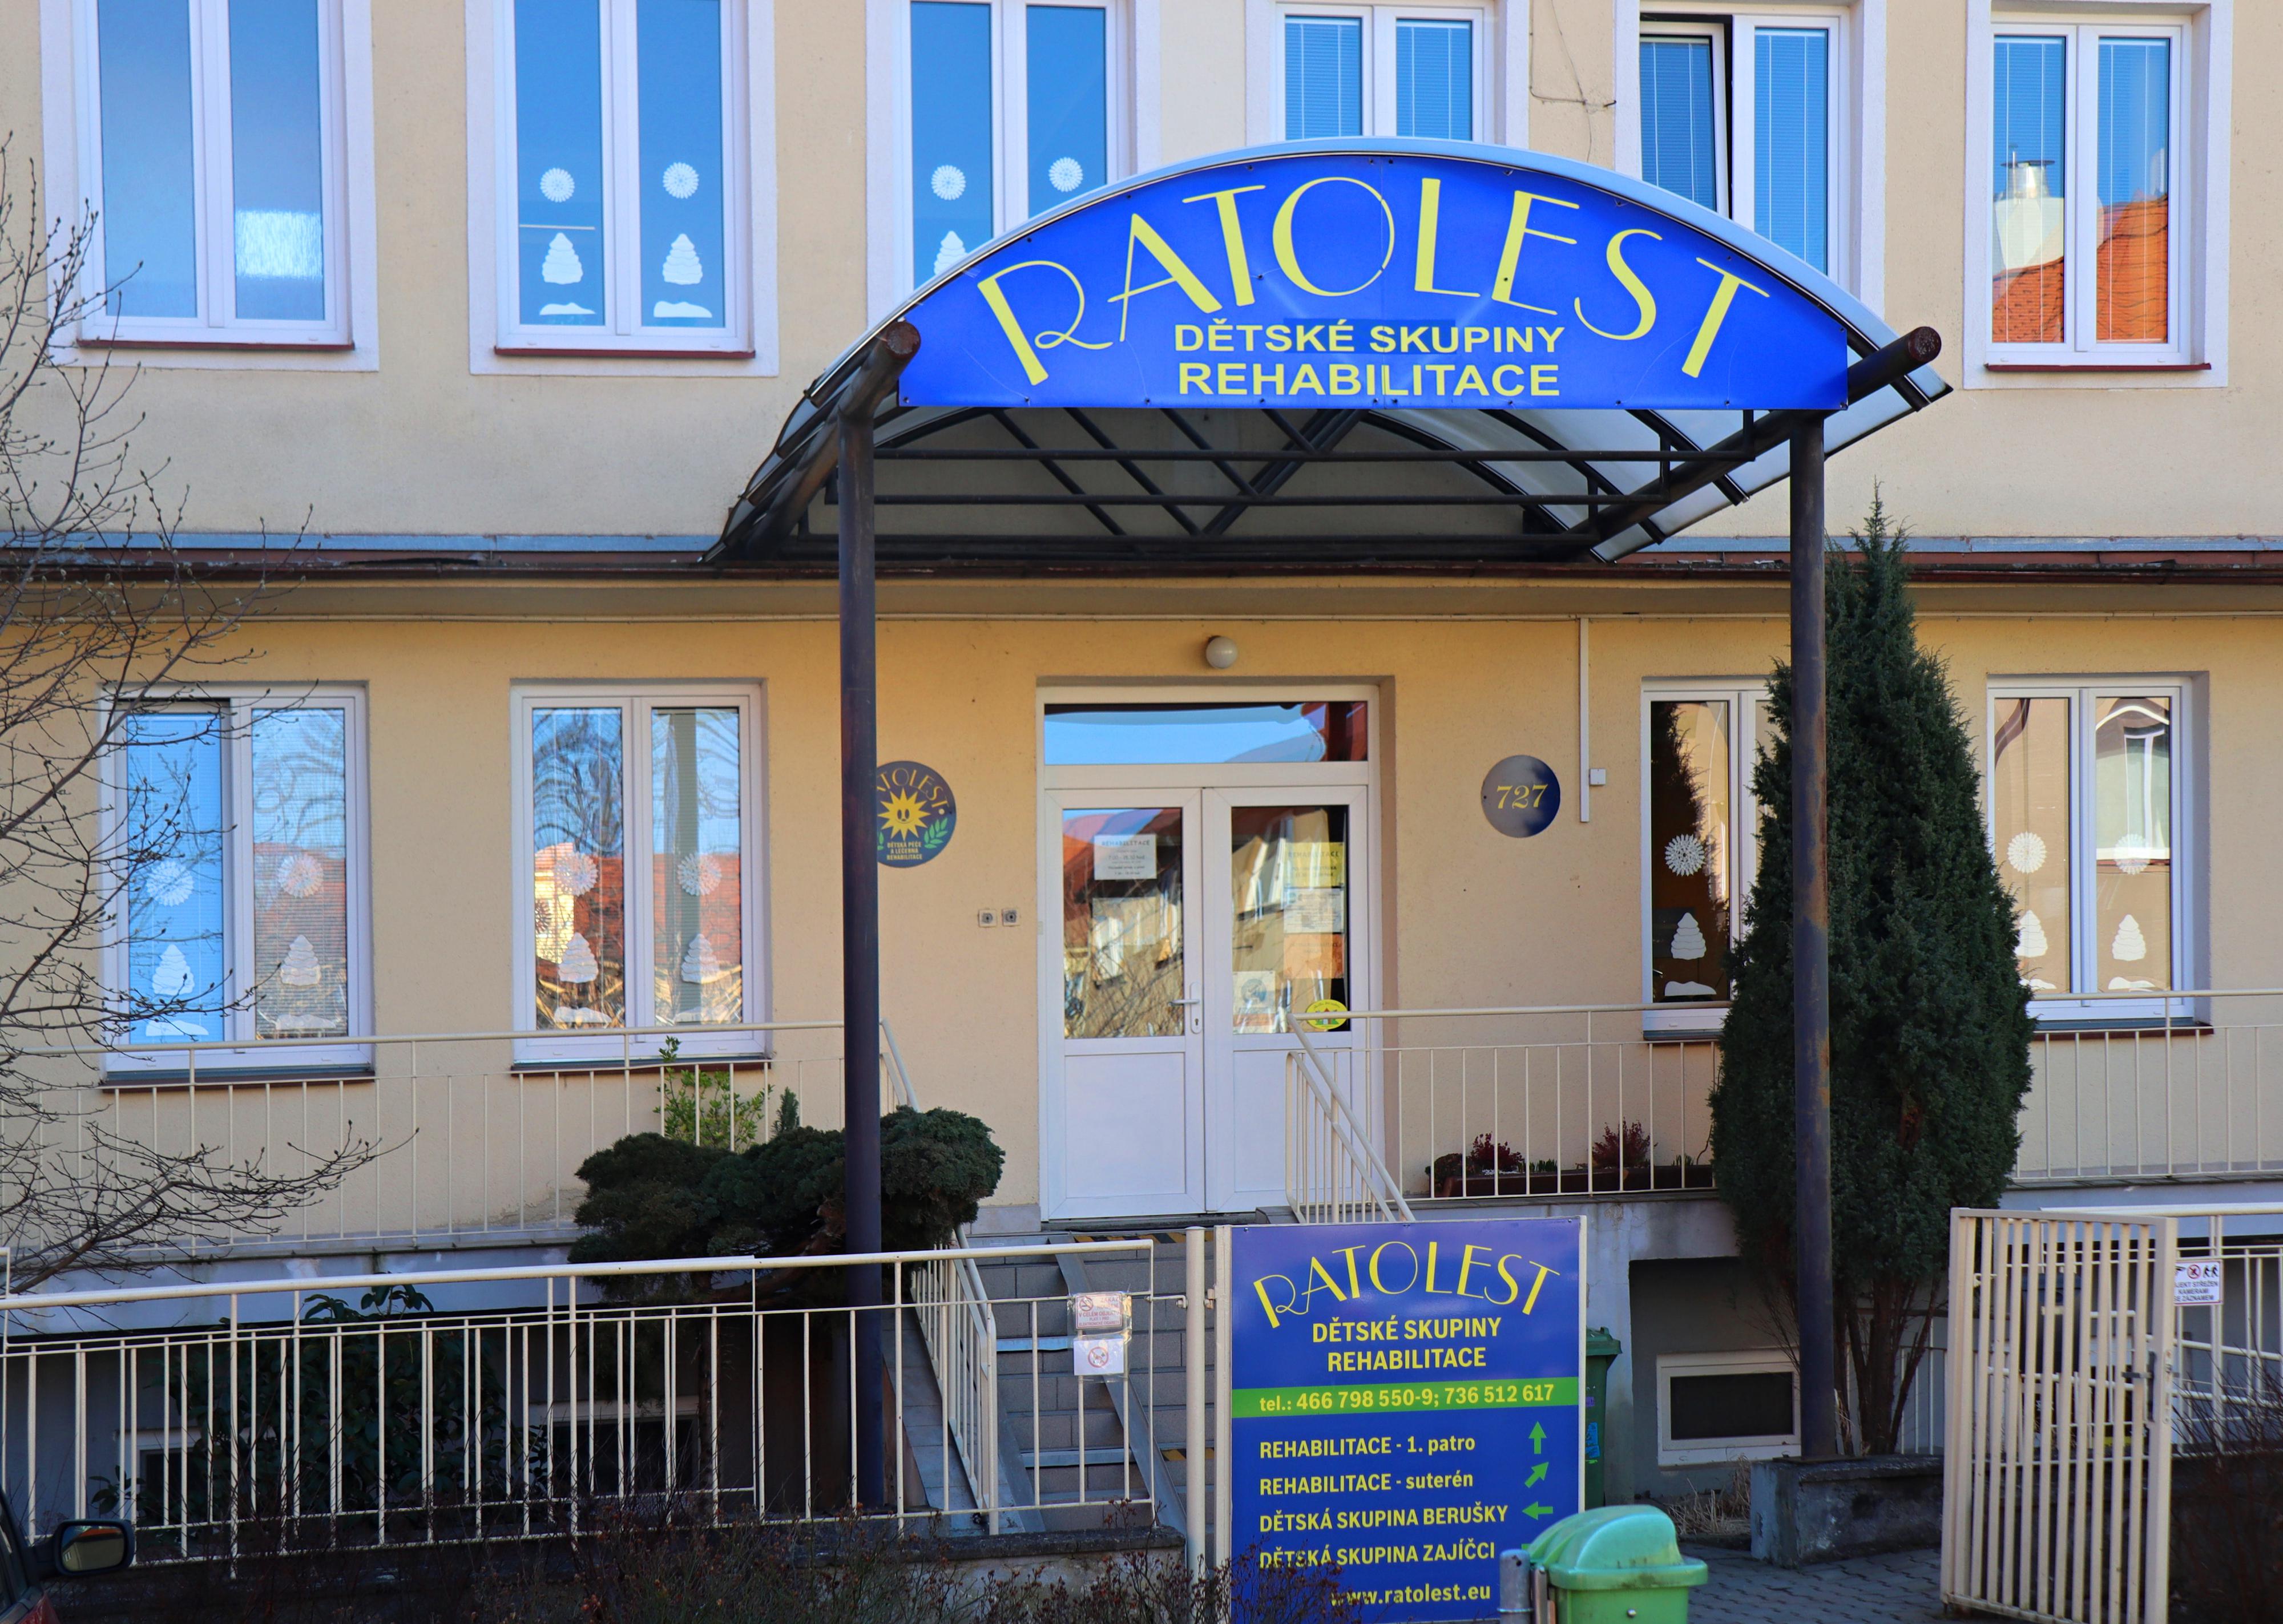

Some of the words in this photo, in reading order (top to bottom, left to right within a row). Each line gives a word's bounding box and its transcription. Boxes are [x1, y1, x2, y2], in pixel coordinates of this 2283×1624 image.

[977, 176, 1769, 385] RATOLEST
[1176, 318, 1354, 351] DĚTSKÉ
[1371, 326, 1563, 353] SKUPINY
[1179, 363, 1559, 395] REHABILITACE
[877, 768, 950, 808] TOLEST
[1497, 784, 1548, 809] 727
[1253, 1241, 1560, 1328] RATOLEST
[1313, 1315, 1399, 1343] DĚTSKÉ
[1403, 1317, 1502, 1340] SKUPINY
[1328, 1347, 1487, 1372] REHABILITACE
[1259, 1395, 1292, 1412] tel.:
[1296, 1392, 1333, 1410] 466
[1338, 1390, 1374, 1408] 798
[1379, 1388, 1439, 1407] 550-9;
[1445, 1386, 1479, 1404] 736
[1484, 1385, 1517, 1403] 512
[1522, 1384, 1554, 1401] 617
[1260, 1437, 1391, 1459] REHABILITACE
[1407, 1436, 1423, 1452] 1.
[1428, 1436, 1475, 1455] patro
[1260, 1473, 1391, 1495] REHABILITACE
[1406, 1470, 1474, 1489] suterén
[1260, 1508, 1333, 1532] DĚTSKÁ
[1337, 1508, 1419, 1529] SKUPINA
[1423, 1502, 1508, 1525] BERUŠKY
[1260, 1545, 1332, 1569] DĚTSKÁ
[1336, 1545, 1419, 1566] SKUPINA
[1422, 1538, 1495, 1561] ZAJÍČCI
[1331, 1583, 1491, 1606] www.ratolest.eu
